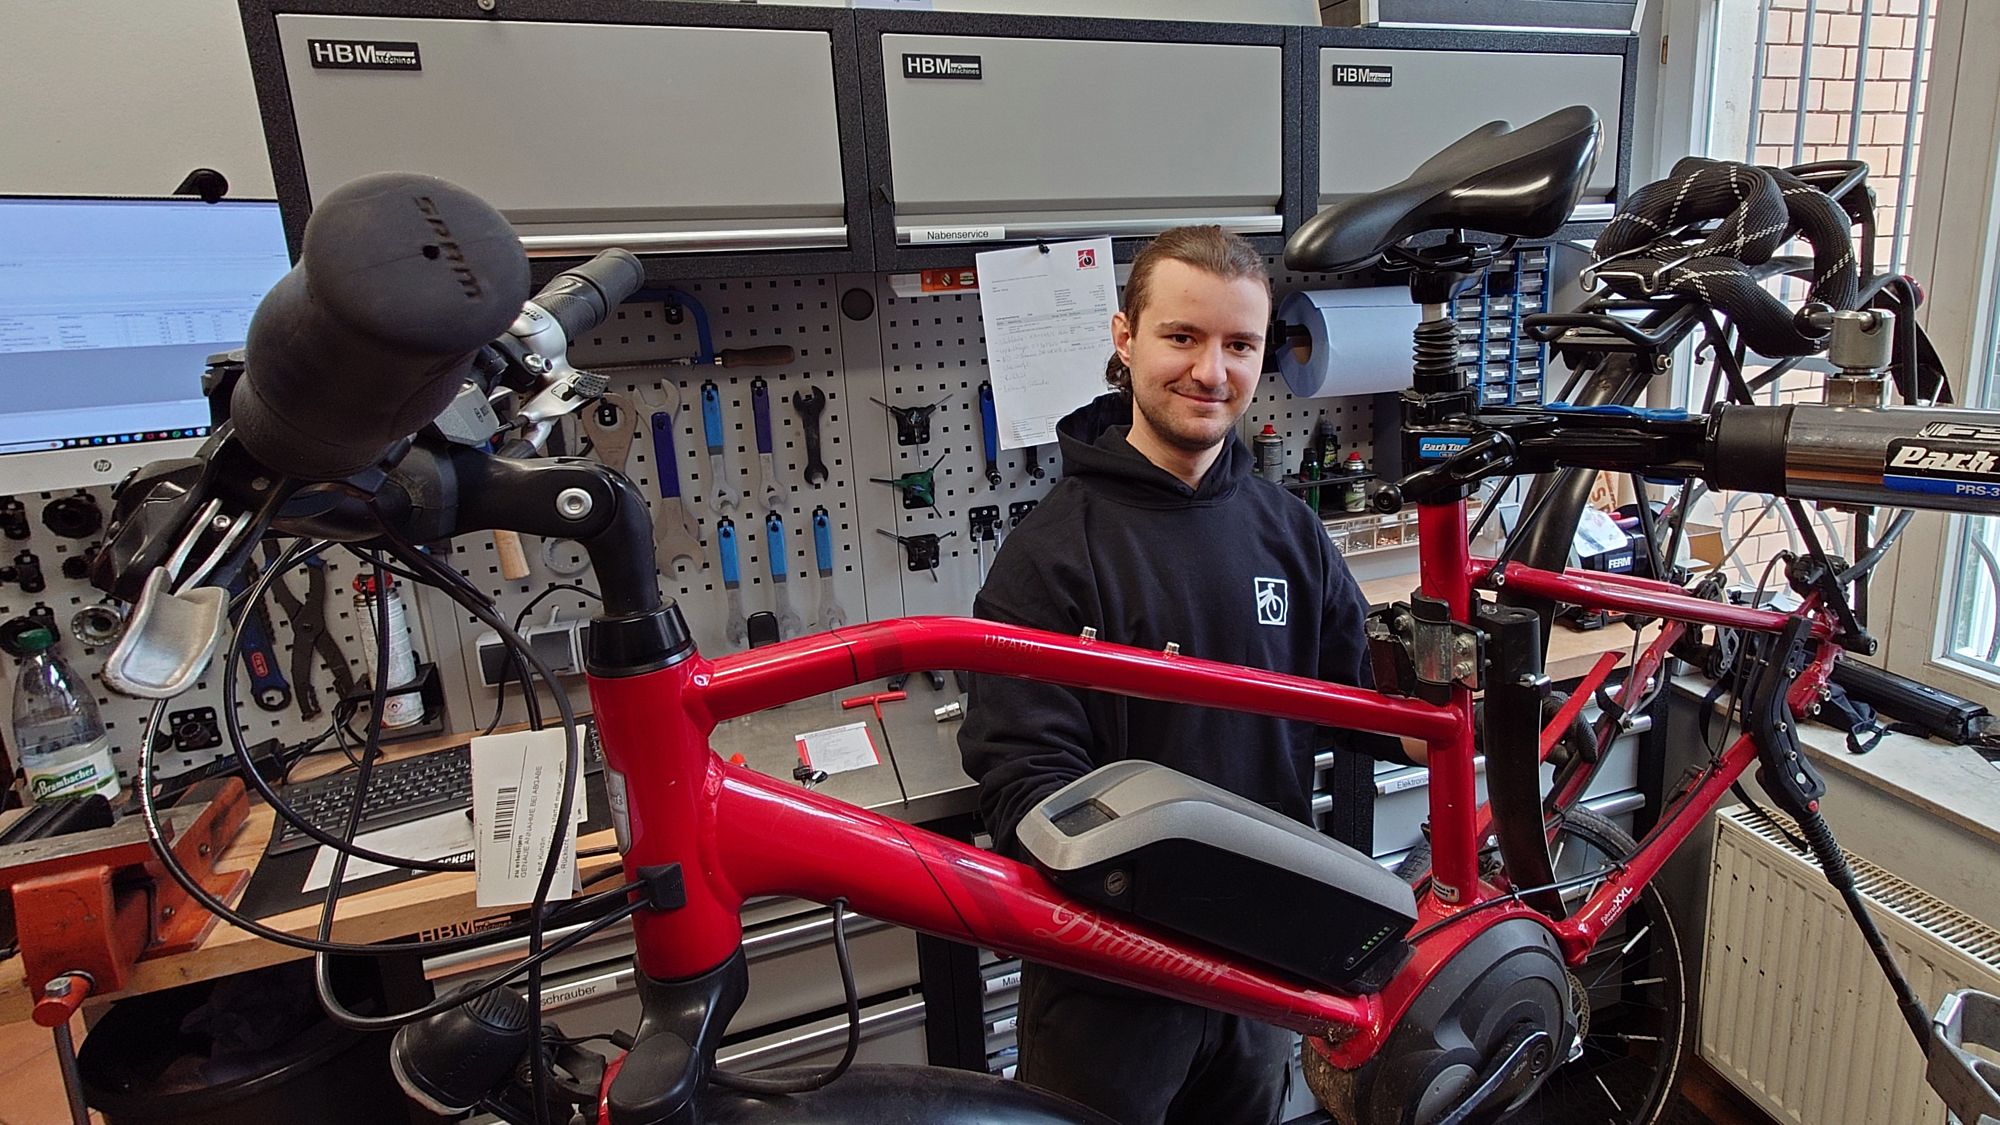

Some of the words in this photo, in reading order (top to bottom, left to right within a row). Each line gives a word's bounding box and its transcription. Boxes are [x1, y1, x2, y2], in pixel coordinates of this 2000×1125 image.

[314, 43, 376, 63] HBM
[375, 55, 417, 65] Machines
[907, 57, 951, 74] HBM
[950, 67, 979, 75] Machines
[1337, 67, 1370, 82] HBM
[927, 229, 989, 240] Nabenservice
[1889, 446, 1999, 473] Park
[1608, 557, 1632, 569] FERM
[39, 767, 95, 796] Brambacher
[533, 765, 543, 795] ABGABE
[524, 807, 536, 845] ANNAHME
[520, 845, 530, 878] GENAUE
[1613, 887, 1633, 906] XXL
[419, 919, 476, 942] HBM
